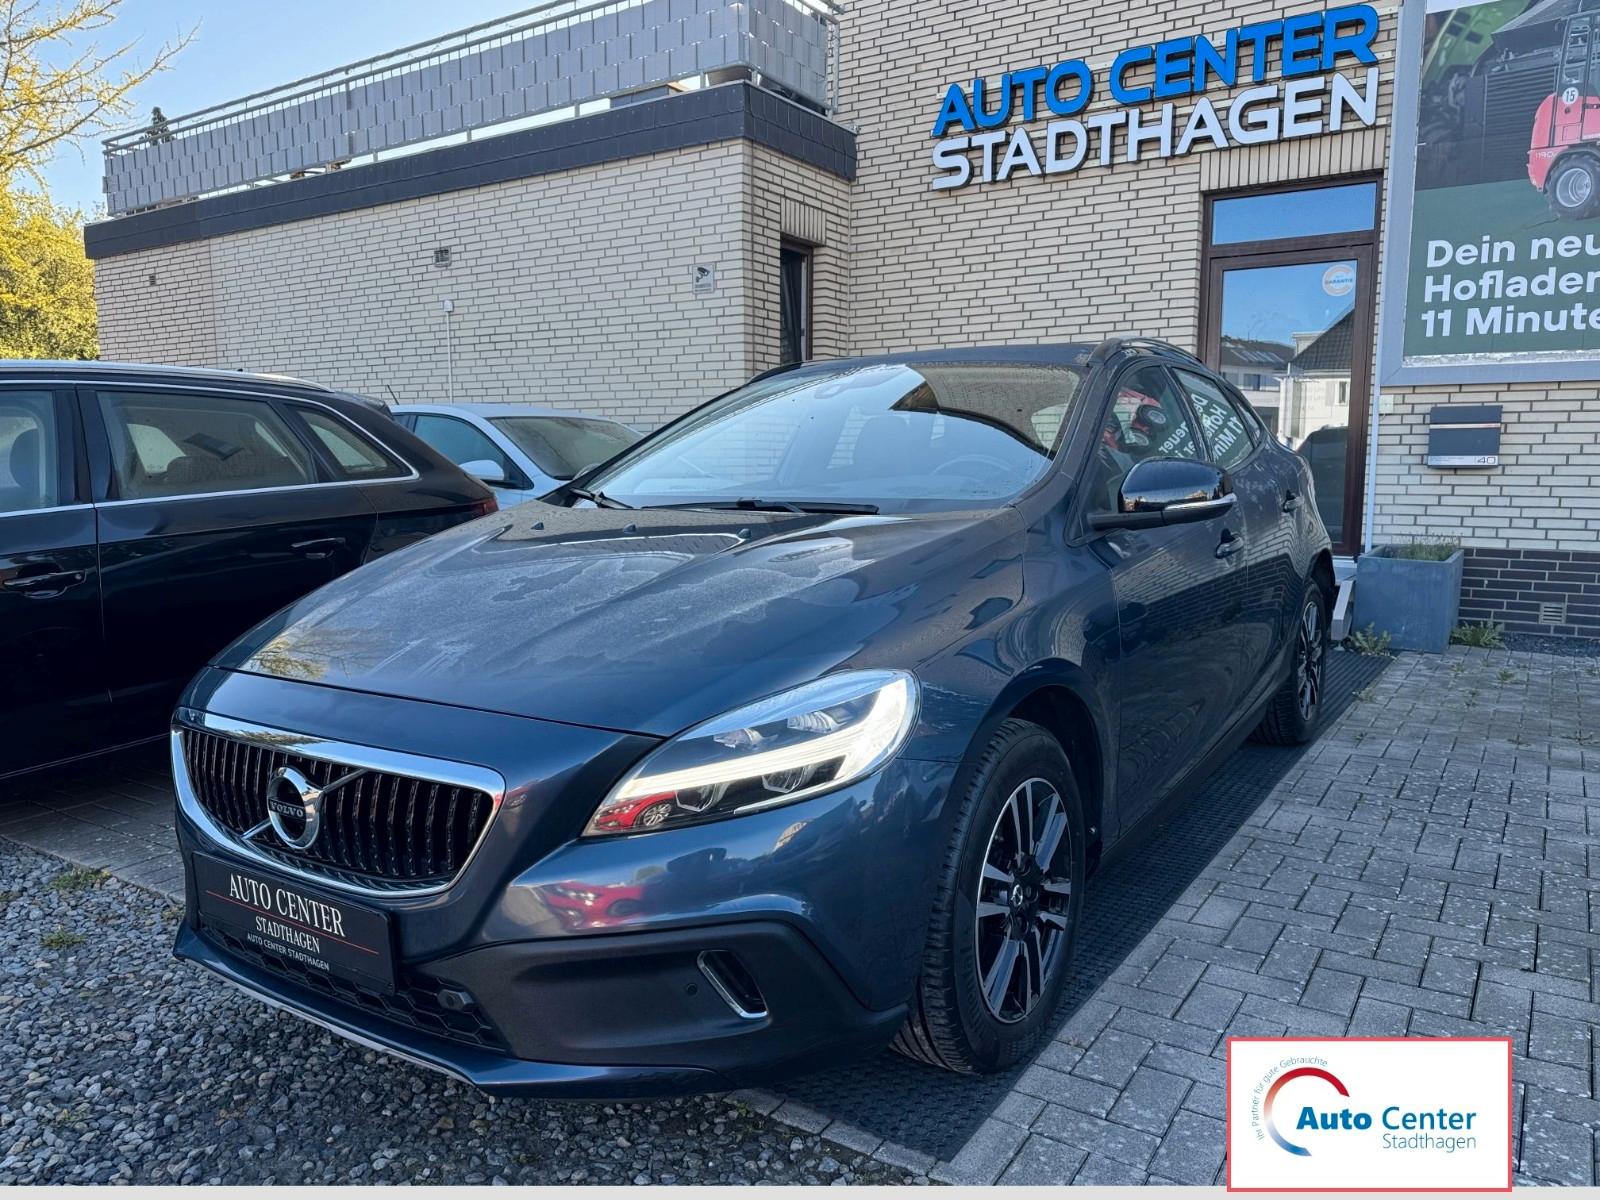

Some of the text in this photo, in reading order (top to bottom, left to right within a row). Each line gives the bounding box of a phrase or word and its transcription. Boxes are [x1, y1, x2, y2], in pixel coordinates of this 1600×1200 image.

[931, 4, 1379, 137] AUTO CENTER
[932, 67, 1379, 190] STADTHAGEN
[1427, 235, 1515, 268] Dein
[1421, 309, 1452, 338] 11
[271, 801, 304, 818] VOLVO
[230, 873, 345, 937] AUTO CENTER
[247, 932, 330, 971] AUTO CENTER STADTHAGEN
[255, 915, 320, 953] STADTHAGEN
